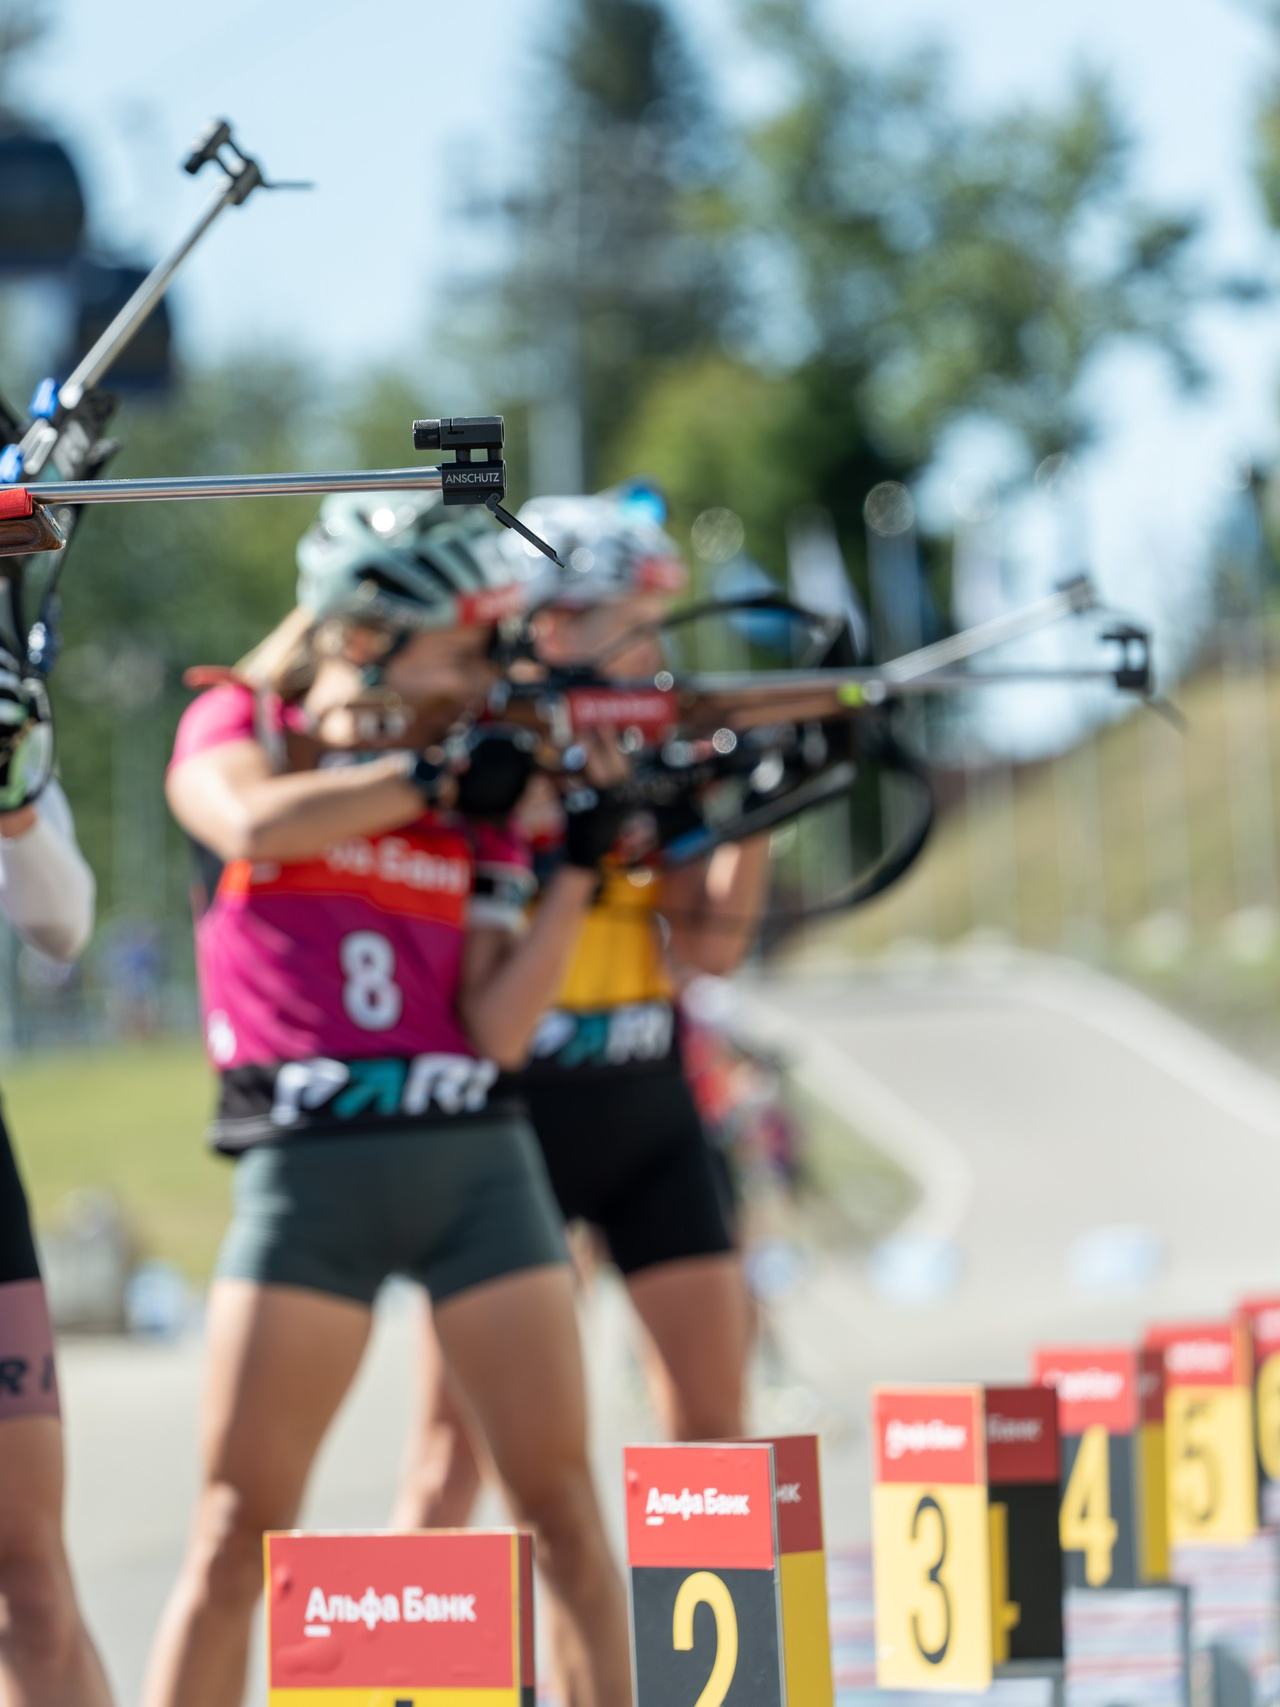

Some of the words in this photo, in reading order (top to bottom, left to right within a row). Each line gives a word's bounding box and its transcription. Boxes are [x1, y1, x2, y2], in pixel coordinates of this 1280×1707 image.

[340, 929, 403, 1031] 8
[270, 1054, 499, 1126] PARI
[645, 1487, 703, 1522] Альфа
[704, 1488, 750, 1517] Банк
[1059, 1423, 1118, 1587] 4
[305, 1587, 400, 1631] Альфа
[403, 1588, 476, 1622] Банк
[910, 1494, 952, 1665] 3
[672, 1571, 738, 1707] 2
